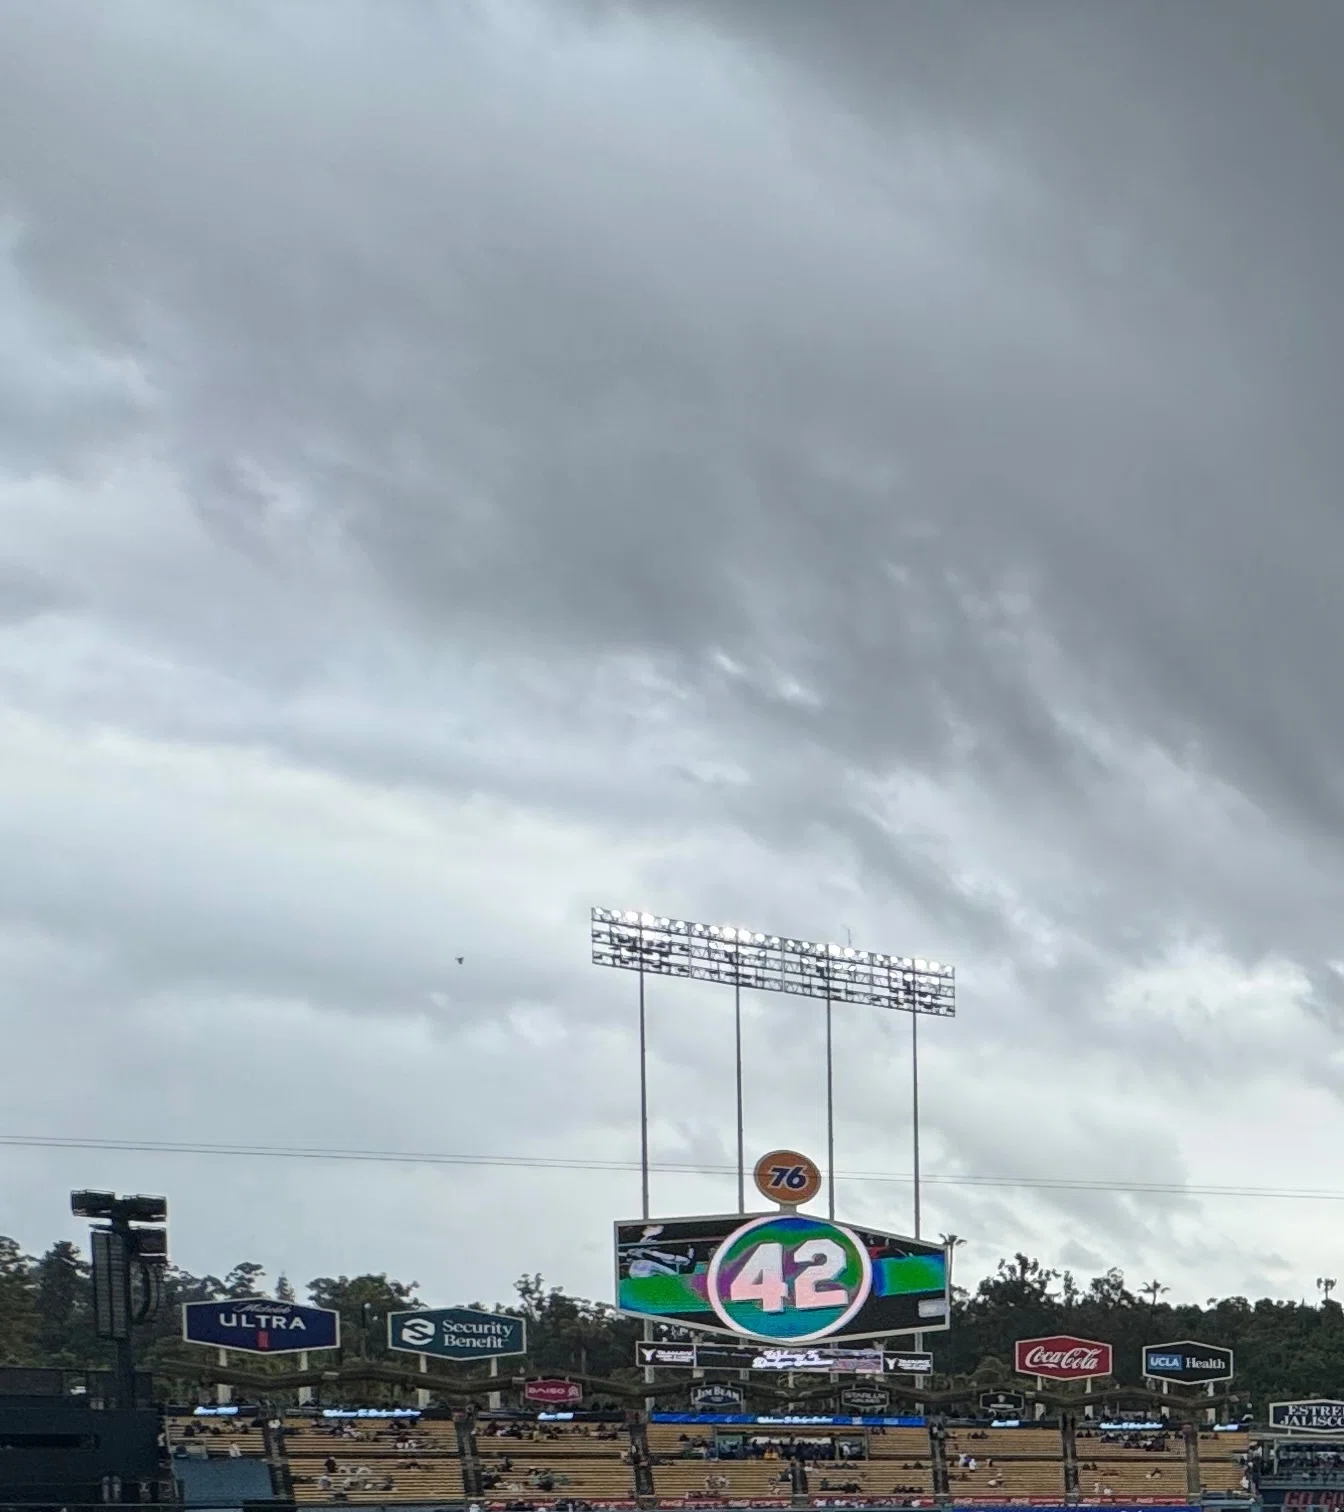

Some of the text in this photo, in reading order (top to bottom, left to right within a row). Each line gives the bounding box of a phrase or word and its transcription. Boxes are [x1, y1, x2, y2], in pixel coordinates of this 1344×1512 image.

[768, 1164, 809, 1190] 76
[730, 1237, 849, 1313] 42
[219, 1313, 306, 1330] ULTRA
[442, 1319, 514, 1337] Security
[444, 1334, 504, 1349] Benefit
[1025, 1346, 1103, 1370] Coca-Cola
[1150, 1356, 1225, 1370] UCLA Health
[697, 1385, 740, 1400] JIM BEAM
